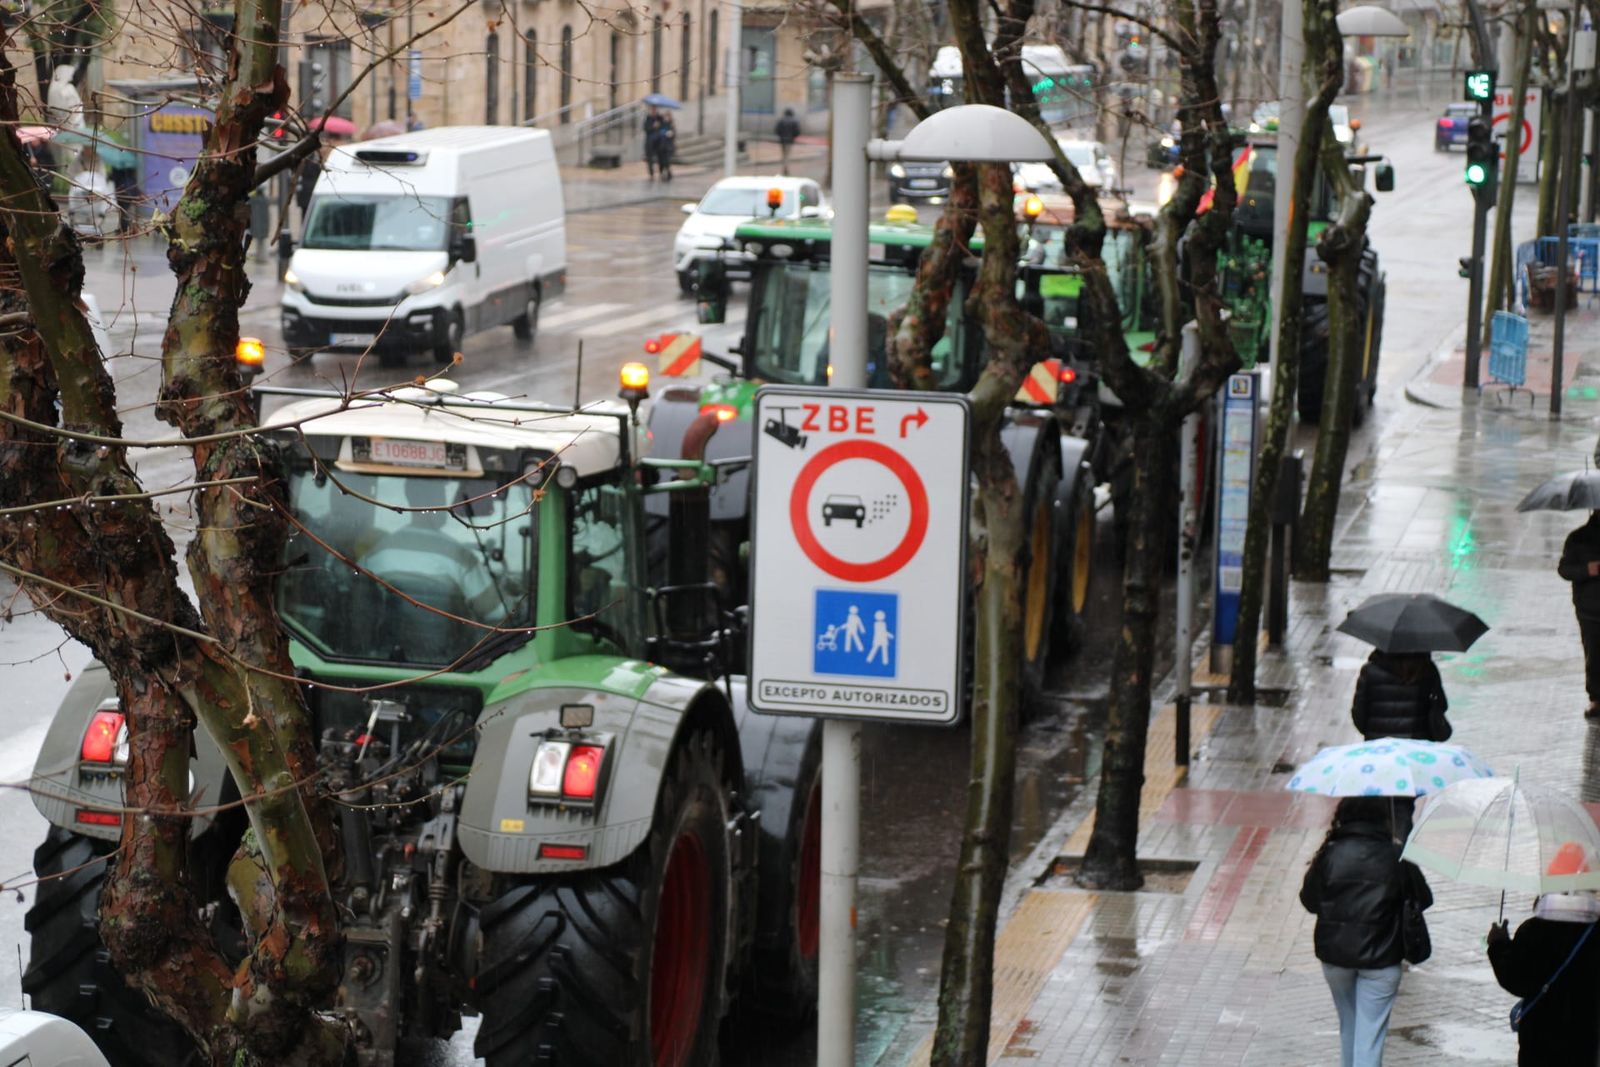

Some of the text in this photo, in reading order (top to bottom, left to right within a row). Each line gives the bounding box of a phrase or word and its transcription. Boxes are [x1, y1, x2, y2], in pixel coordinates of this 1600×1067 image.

[802, 404, 875, 434] ZBE
[765, 686, 942, 706] EXCEPTO AUTORIZADOS
